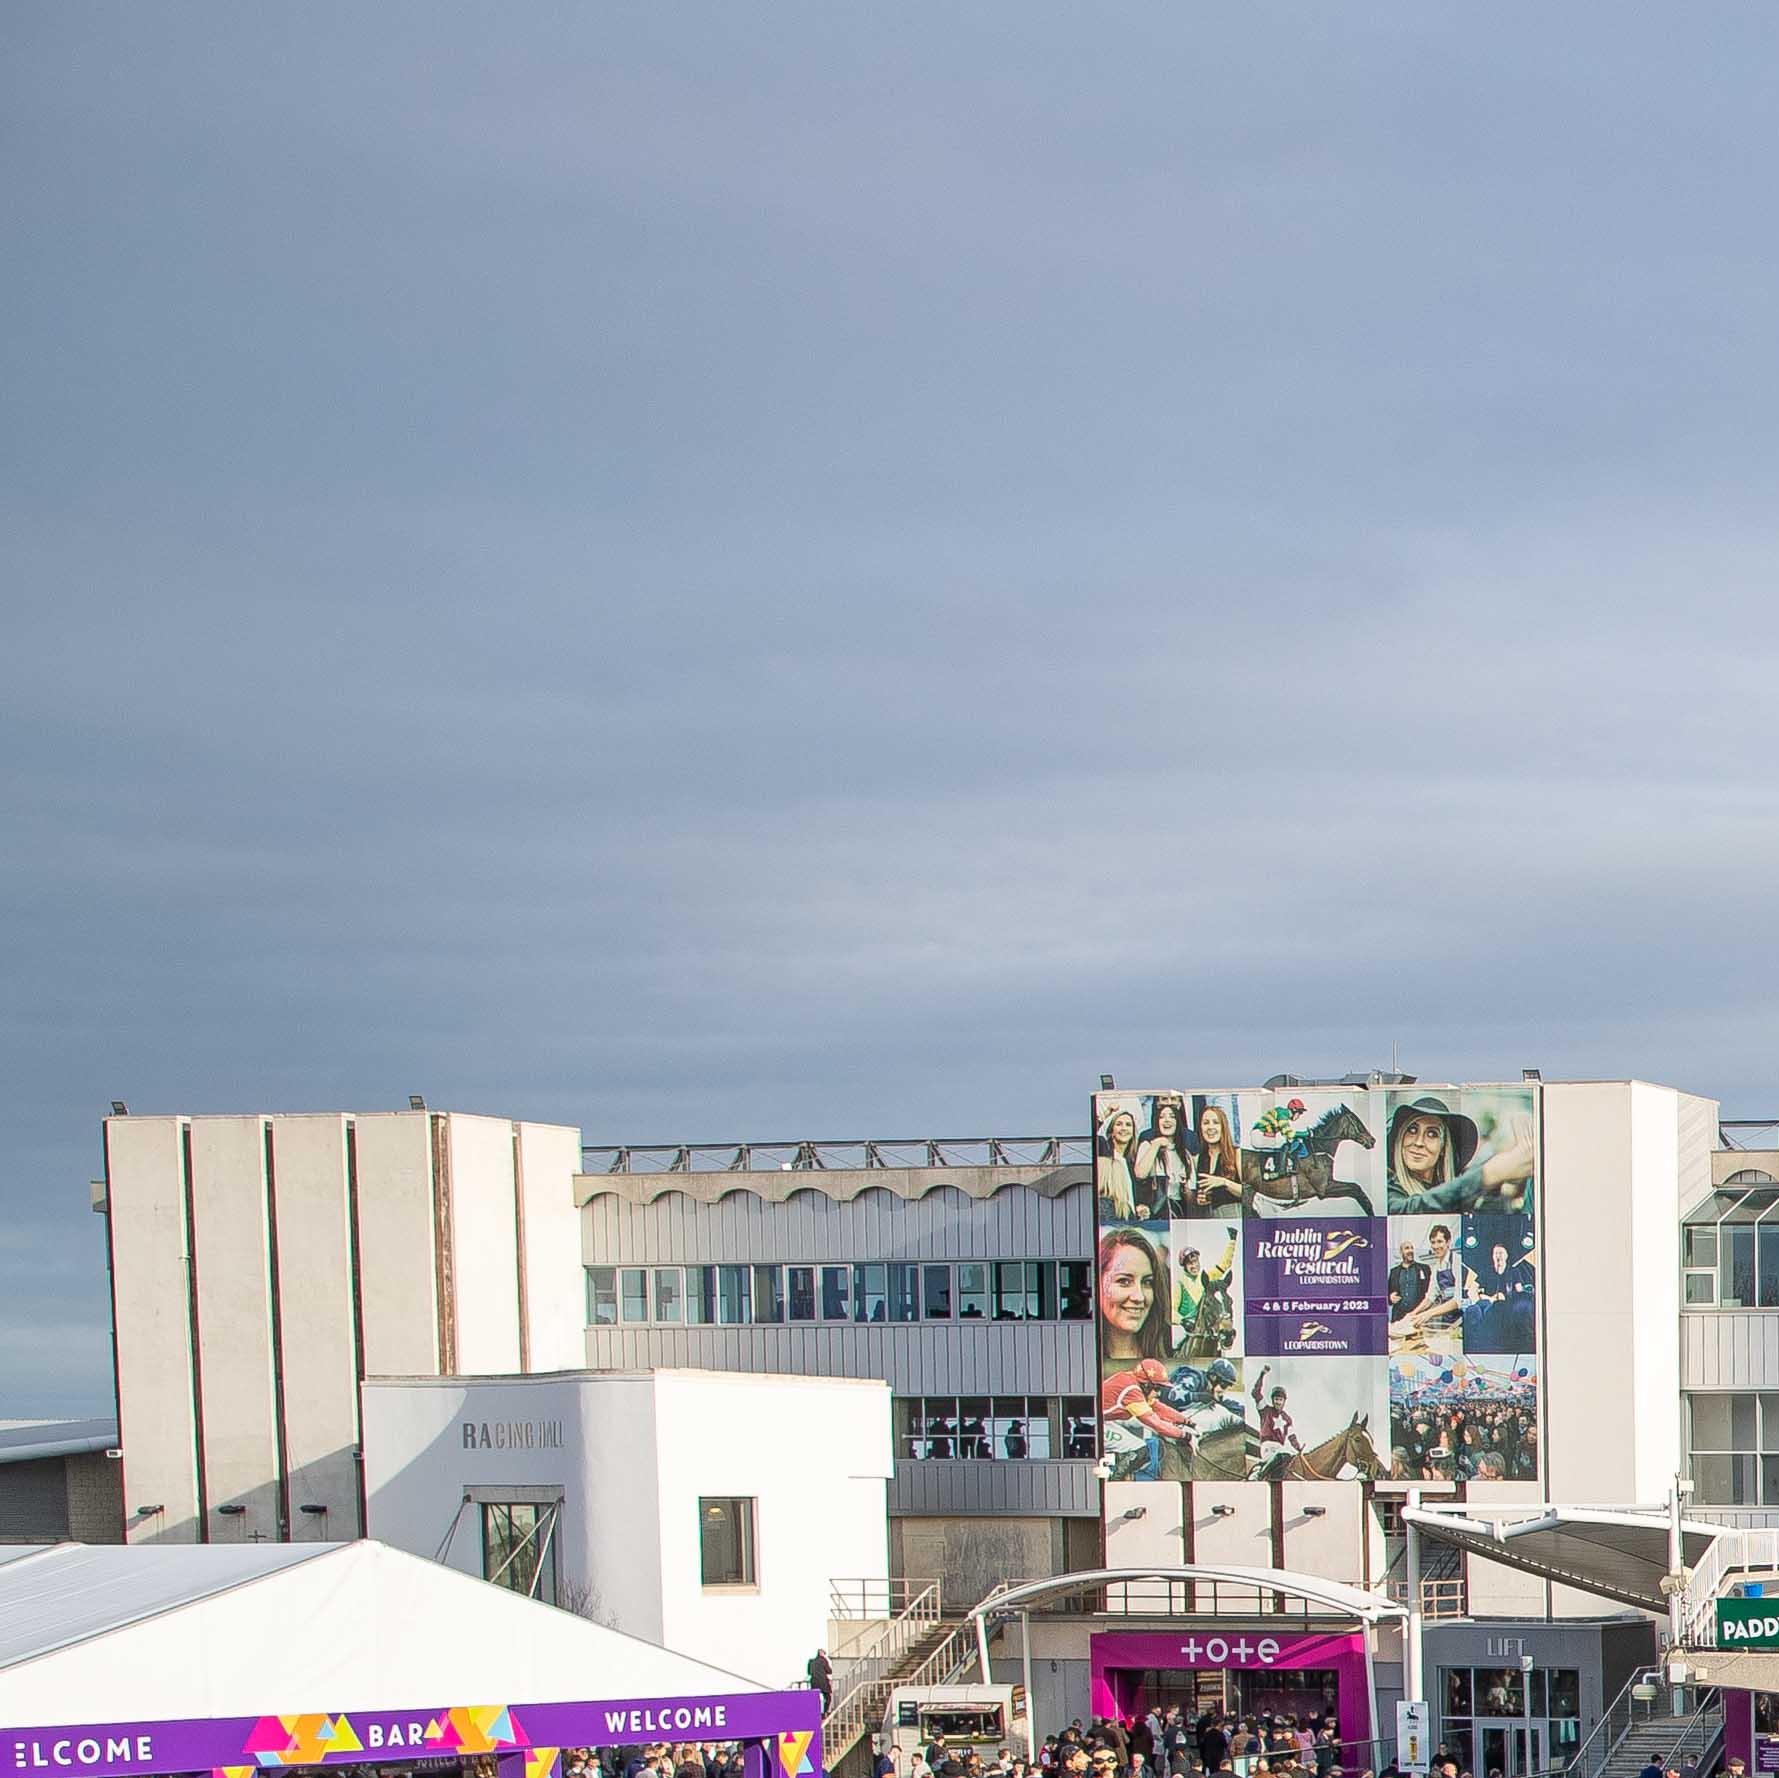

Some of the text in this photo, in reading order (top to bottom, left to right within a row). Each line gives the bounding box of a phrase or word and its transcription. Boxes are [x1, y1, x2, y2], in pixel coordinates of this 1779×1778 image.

[1274, 1228, 1321, 1244] Dublin
[1256, 1241, 1322, 1261] Racing
[1284, 1256, 1354, 1275] Festival
[1299, 1276, 1360, 1285] LEOPARDSTOWN
[1262, 1302, 1271, 1311] 4
[1282, 1301, 1290, 1311] 5
[1291, 1301, 1341, 1312] February
[1342, 1300, 1370, 1310] 2023
[1284, 1341, 1349, 1351] LEOPARDSTOWN
[463, 1423, 535, 1450] RACING
[1486, 1637, 1526, 1657] LIFT
[605, 1705, 728, 1735] WELCOME
[368, 1722, 424, 1749] BAR
